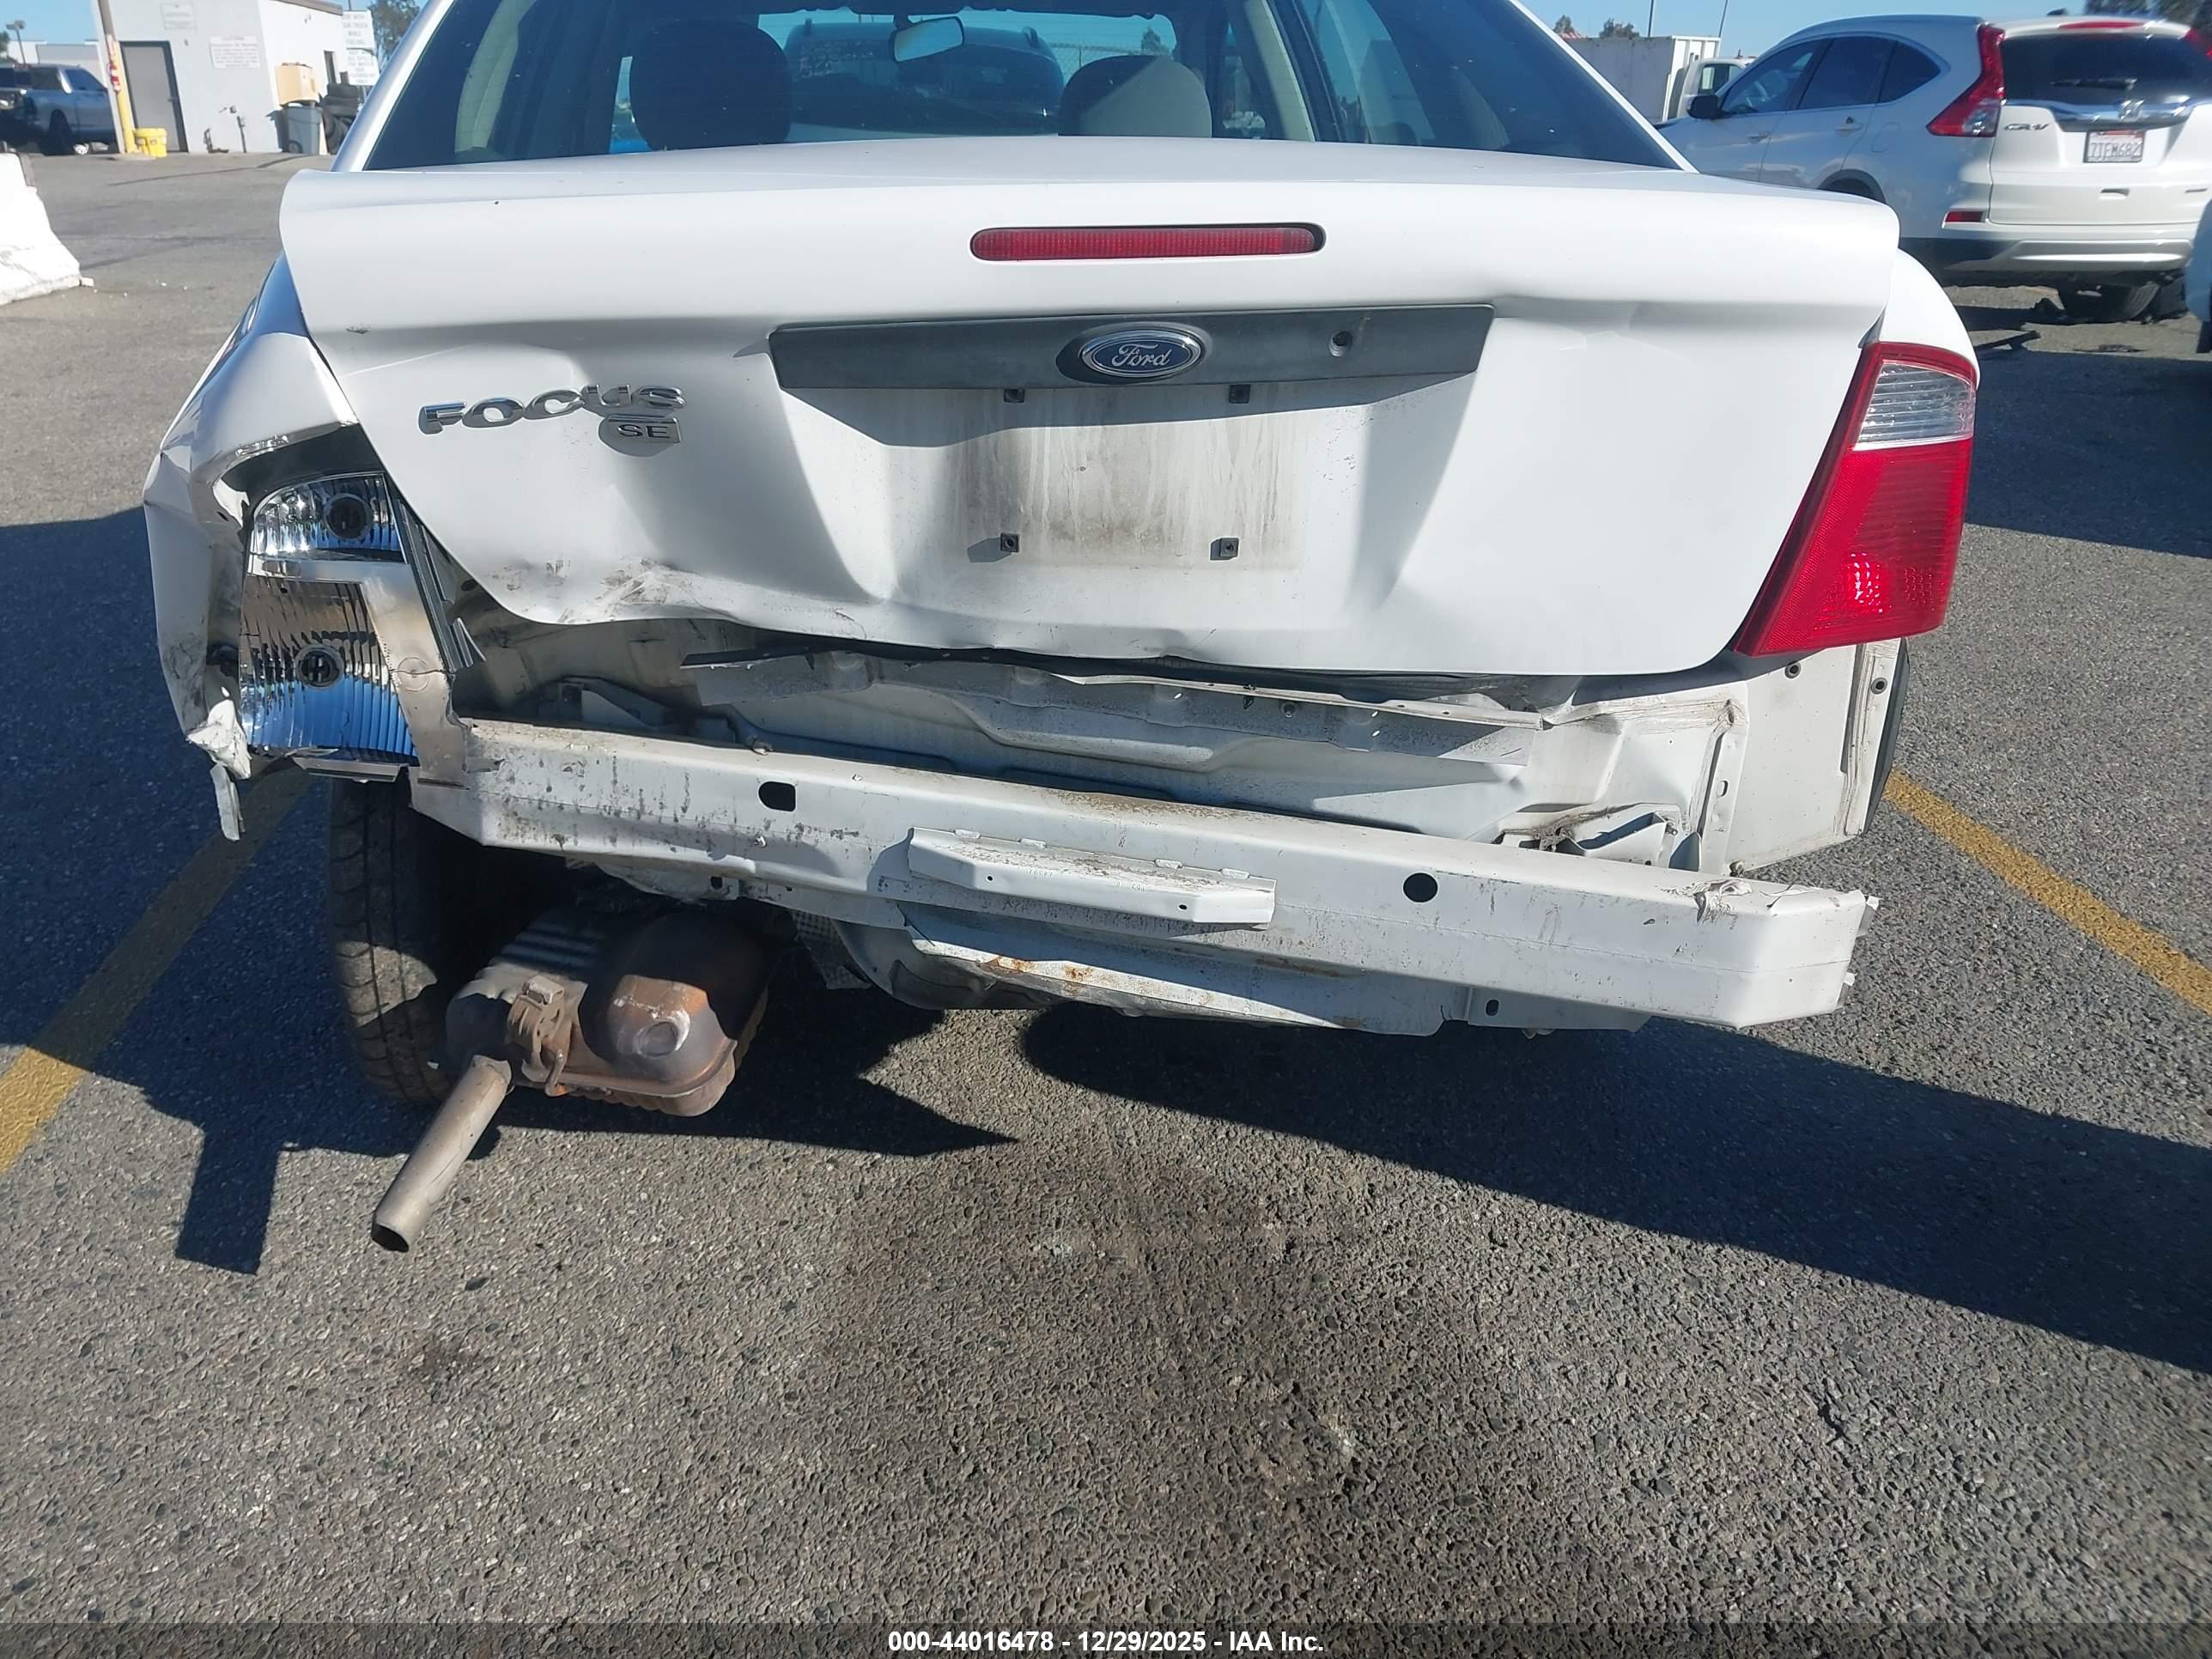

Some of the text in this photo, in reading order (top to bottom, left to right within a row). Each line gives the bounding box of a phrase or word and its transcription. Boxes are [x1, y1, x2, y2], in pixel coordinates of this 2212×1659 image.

[1111, 343, 1173, 367] Ford
[420, 384, 686, 434] FOCUS
[617, 423, 672, 439] SE
